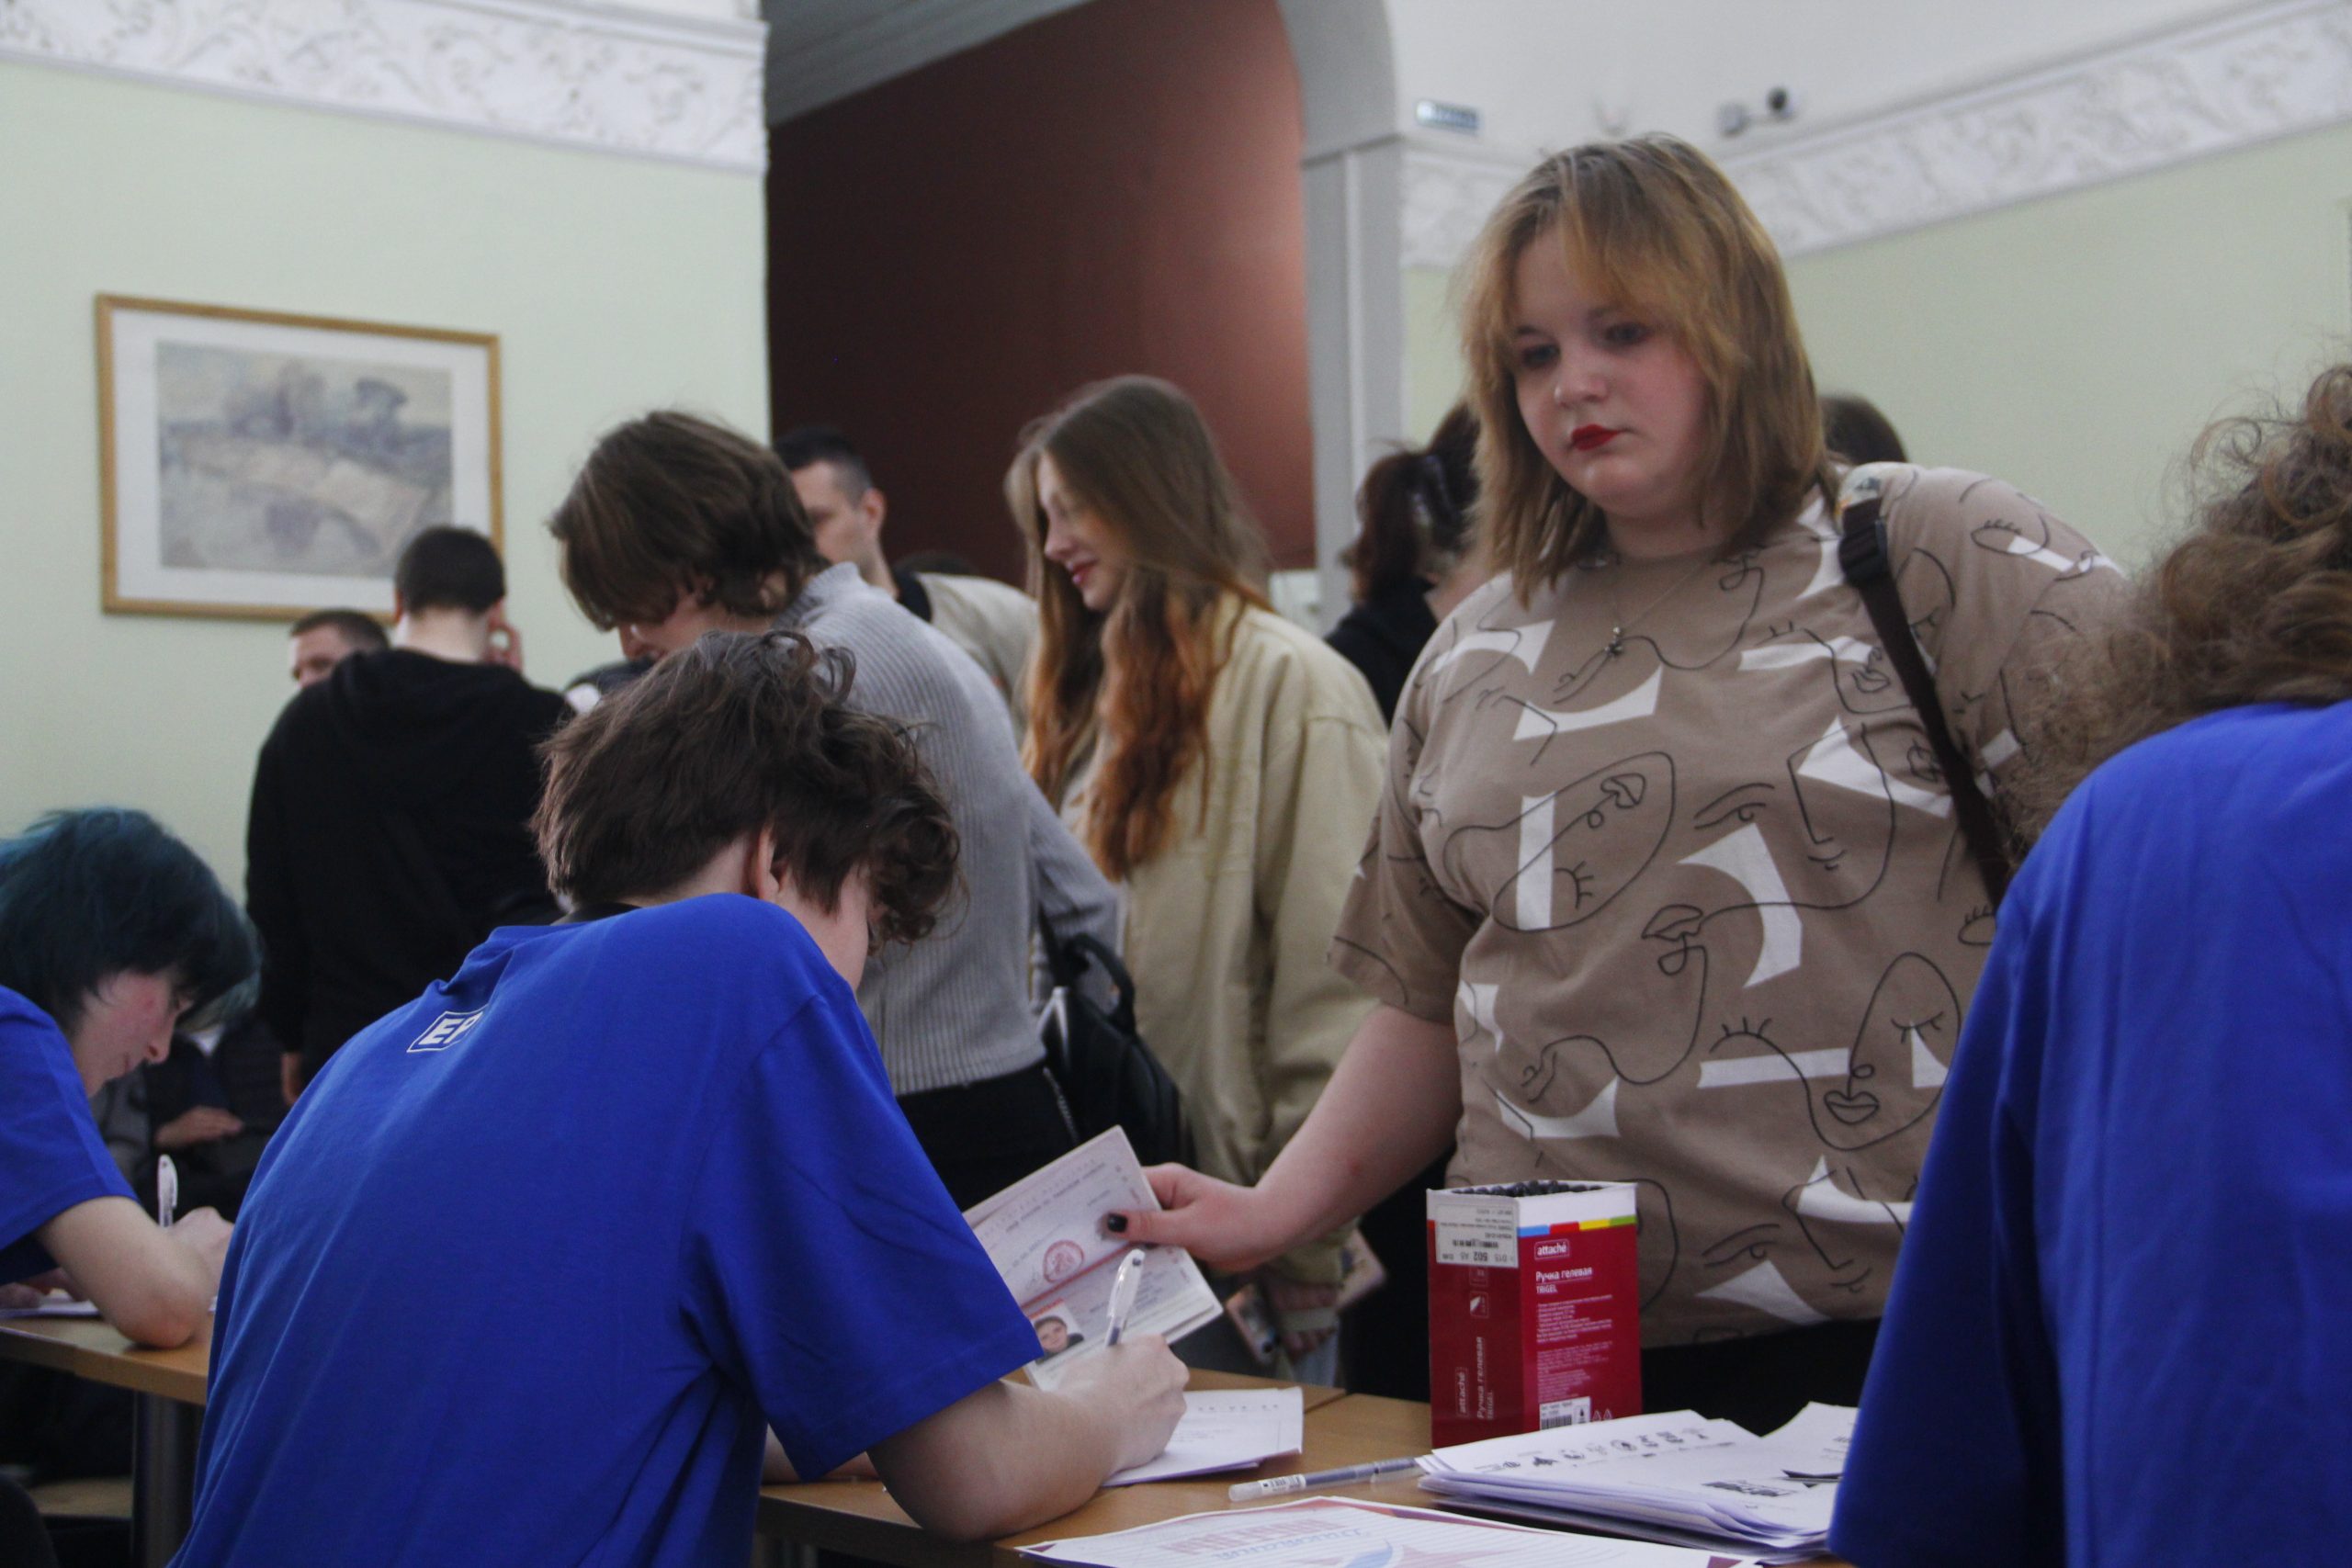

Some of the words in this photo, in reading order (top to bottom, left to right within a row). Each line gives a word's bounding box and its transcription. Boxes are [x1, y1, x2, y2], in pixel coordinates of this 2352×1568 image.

[1537, 1243, 1566, 1257] attaché
[1535, 1270, 1560, 1283] Ручка
[1561, 1267, 1592, 1280] гелевая
[1476, 1337, 1484, 1383] гелевая
[1476, 1386, 1486, 1419] Ручка
